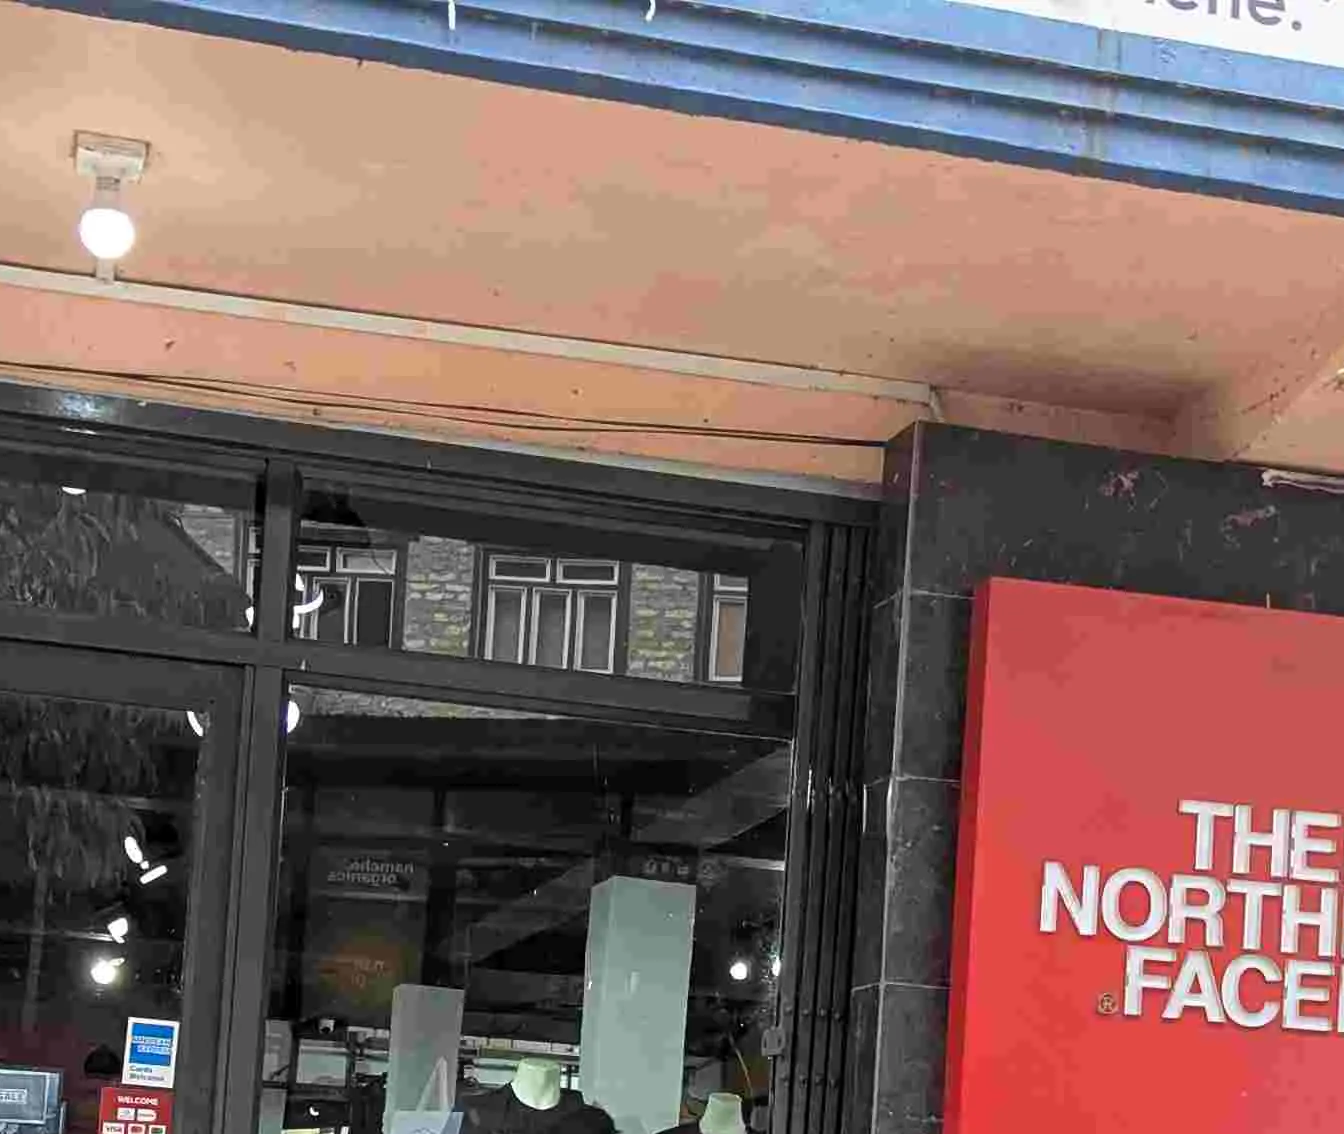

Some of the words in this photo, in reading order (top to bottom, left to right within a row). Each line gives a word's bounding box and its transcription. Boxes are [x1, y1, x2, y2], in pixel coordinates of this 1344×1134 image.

[1178, 799, 1343, 882] THE
[1039, 861, 1340, 958] NORTH
[1123, 946, 1340, 1033] FACE
[117, 1095, 159, 1106] WELCOME
